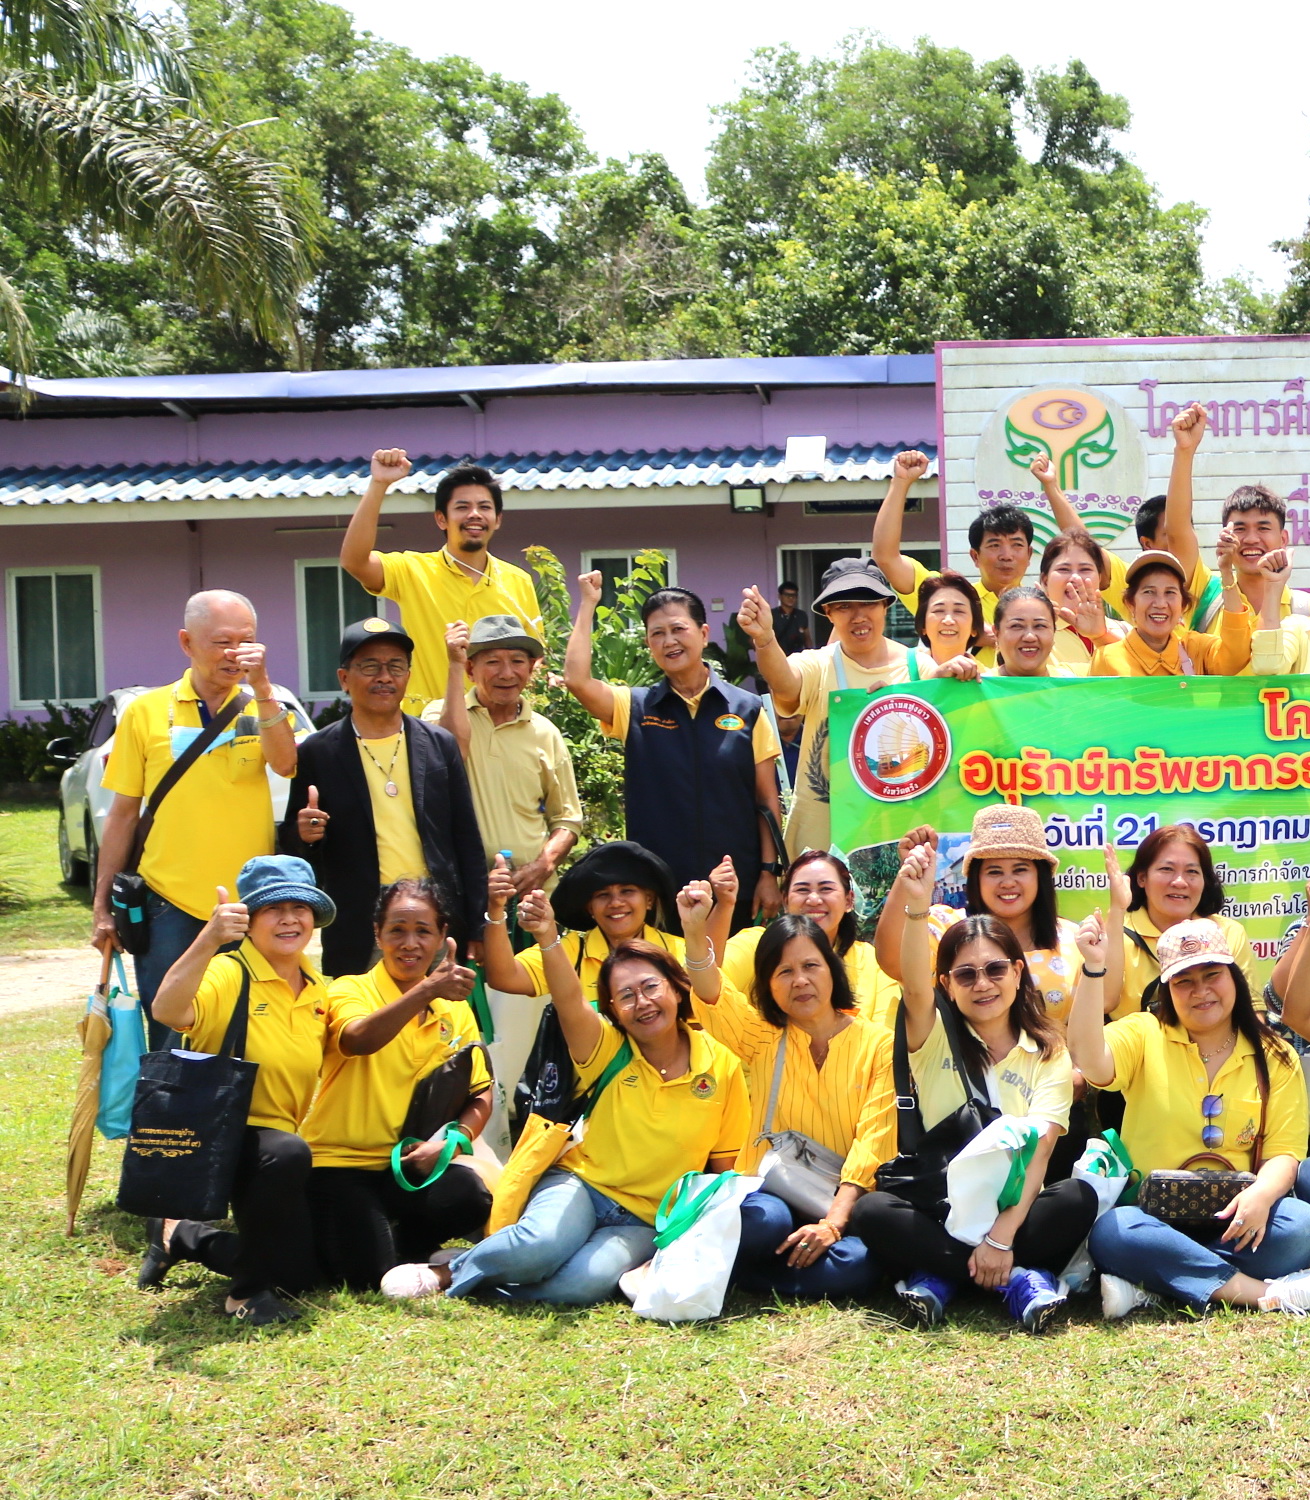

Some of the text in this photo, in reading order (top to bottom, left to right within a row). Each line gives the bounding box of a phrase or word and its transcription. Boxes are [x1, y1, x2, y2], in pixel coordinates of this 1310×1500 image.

[1044, 807, 1104, 846] วันที่
[1117, 816, 1156, 846] 21
[1179, 817, 1310, 849] รกฎาคม
